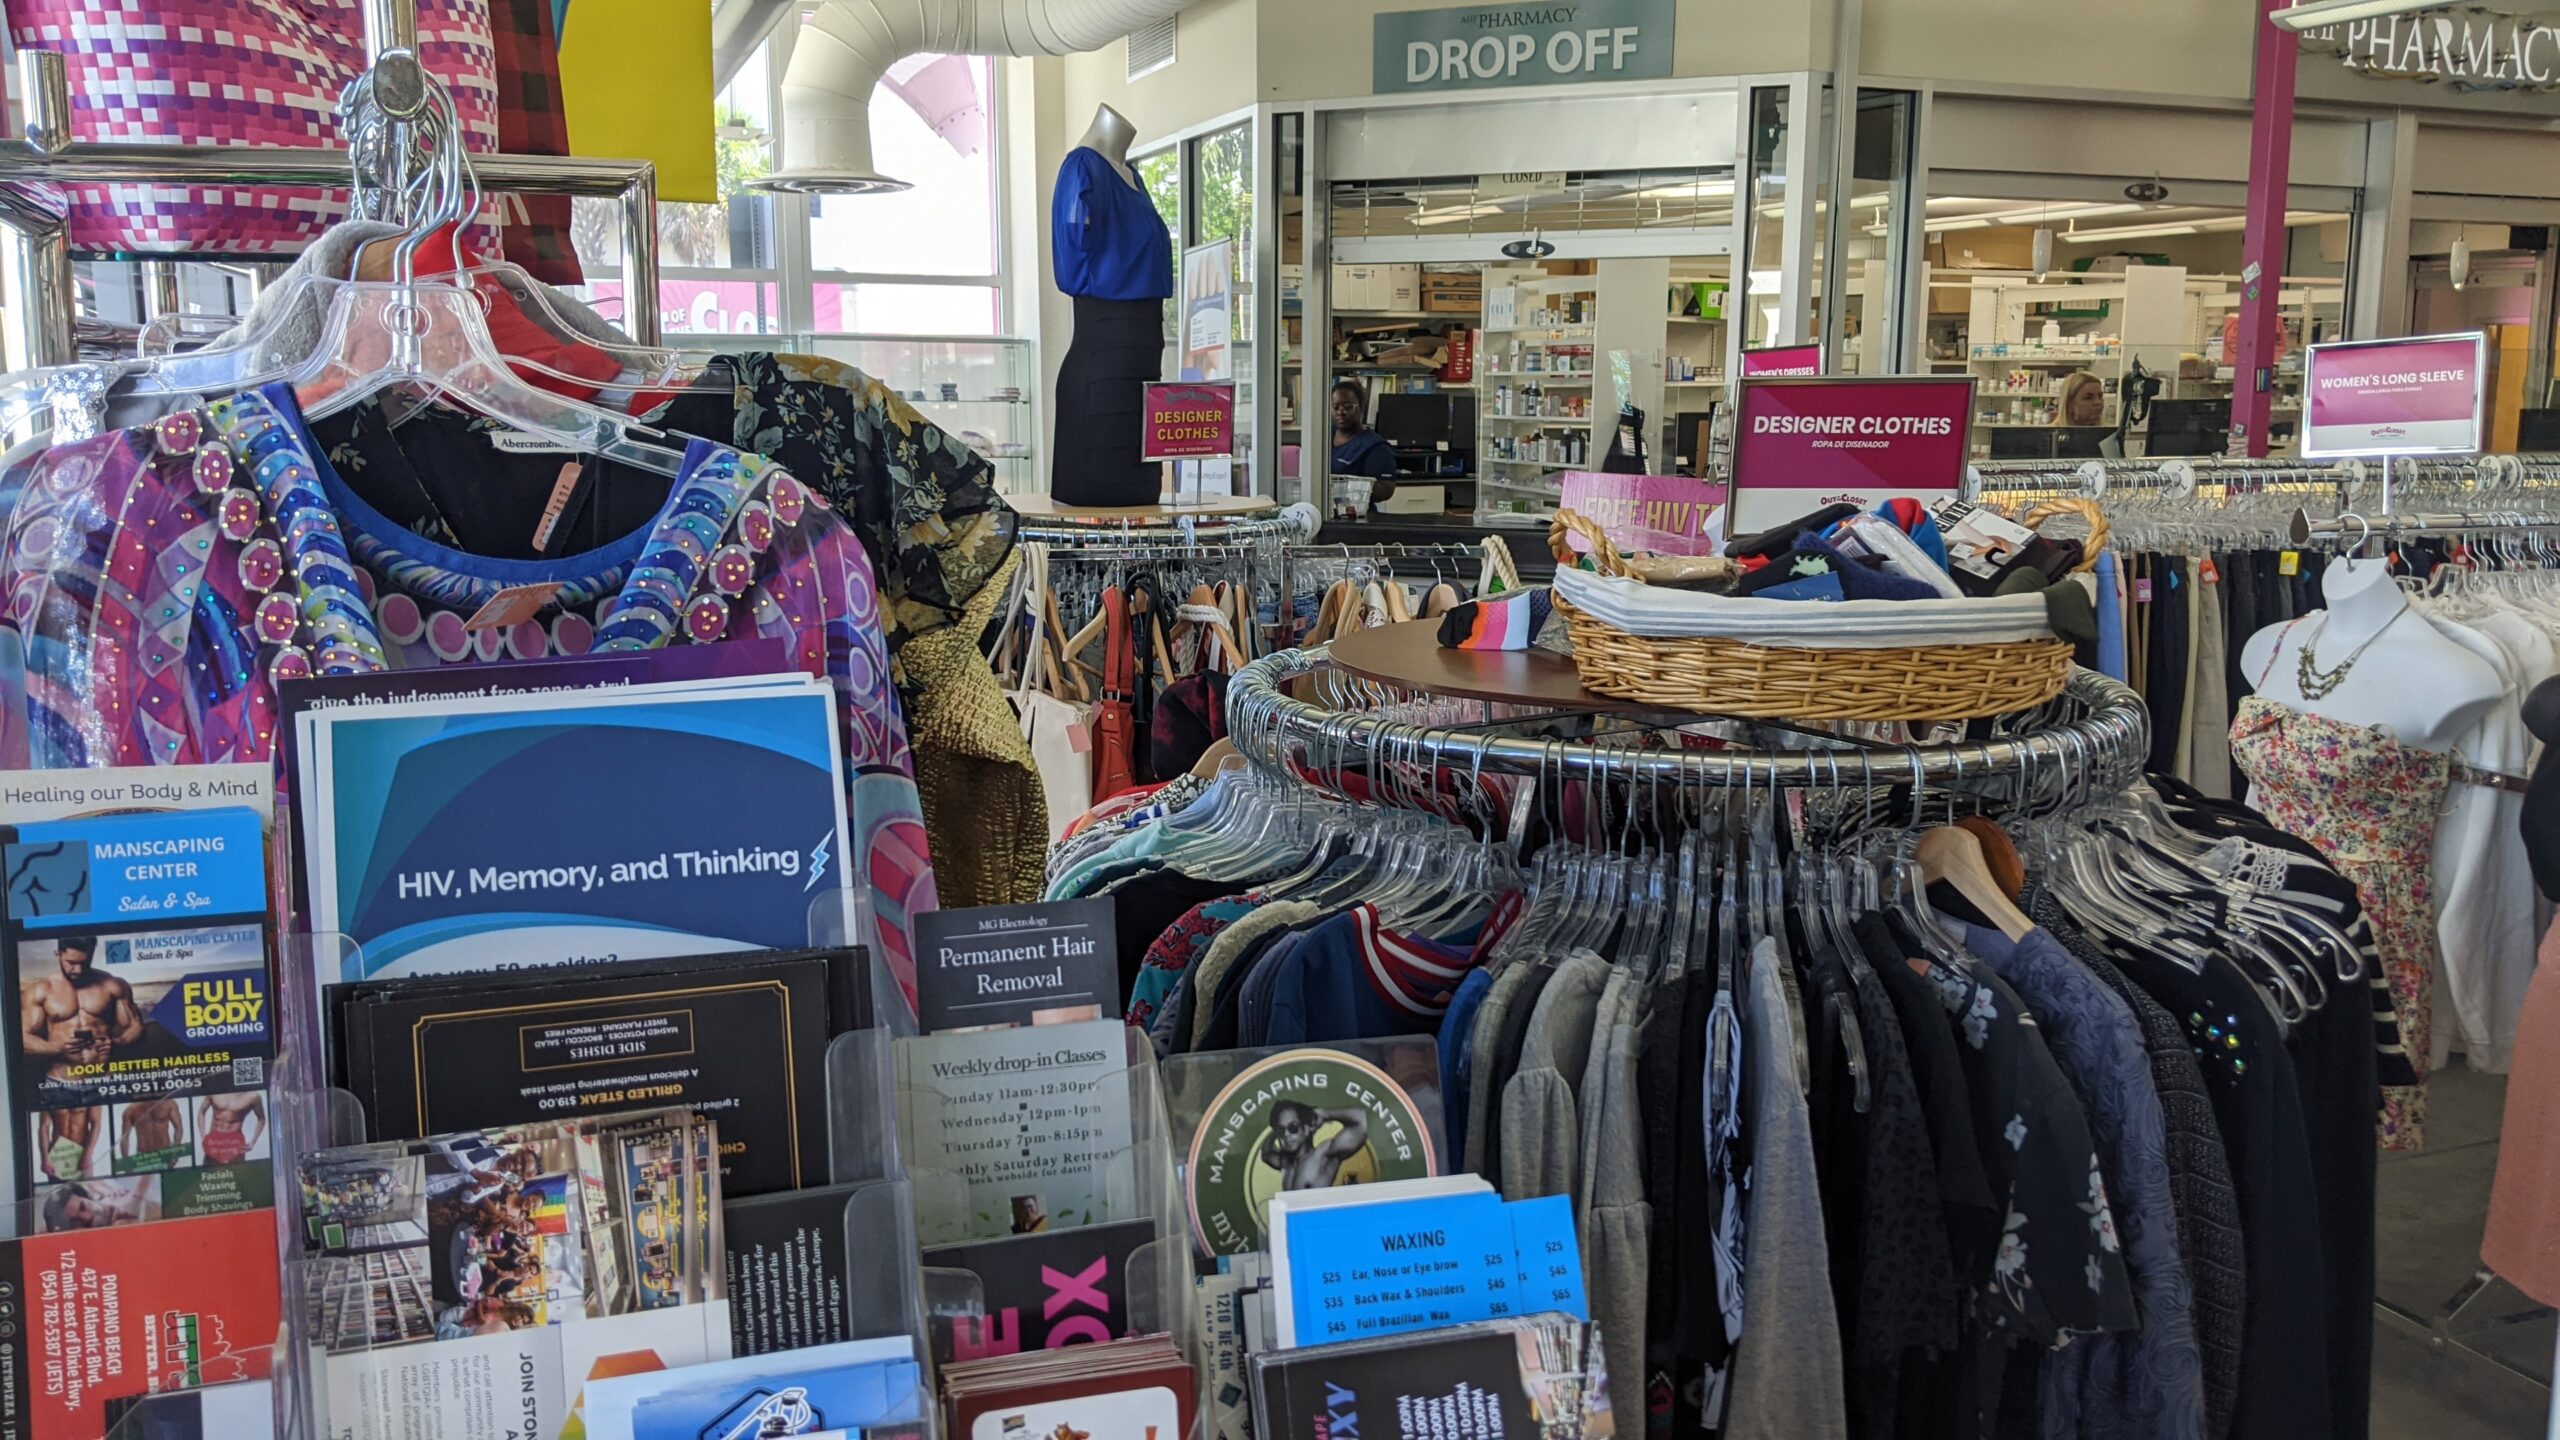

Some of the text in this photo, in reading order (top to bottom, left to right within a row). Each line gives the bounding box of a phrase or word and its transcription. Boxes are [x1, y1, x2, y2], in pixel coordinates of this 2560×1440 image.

[1479, 8, 1576, 28] PHARMACY
[1407, 26, 1639, 83] DROP OFF
[2343, 15, 2560, 82] PHARMAC
[671, 308, 686, 323] OF
[1784, 367, 1815, 376] DRESSES
[2321, 370, 2464, 389] WOMEN'S LONG SLEEVE
[1155, 411, 1222, 424] DESIGNER
[1753, 416, 1952, 435] DESIGNER CLOTHES
[1157, 427, 1219, 440] CLOTHES
[1812, 440, 1833, 448] ROPA
[1820, 493, 1868, 507] OUT CLOSET
[1584, 496, 1641, 528] FREE
[1645, 501, 1691, 535] HIV
[5, 780, 258, 804] Healing our Body & Mind
[95, 836, 225, 859] MANSCAPING
[125, 862, 198, 881] CENTER
[398, 846, 801, 899] HIV, Memory, and Thinking
[118, 891, 211, 912] Salon & Spa
[978, 915, 1048, 931] MG Electrology
[134, 930, 257, 950] MANSCAPING CENTER
[137, 949, 193, 961] Salon & Spa
[939, 936, 1095, 968] Permanent Hair
[183, 978, 263, 1005] FULL
[976, 966, 1063, 995] Removal
[185, 999, 264, 1027] BODY
[186, 1022, 264, 1038] GROOMING
[534, 1026, 679, 1048] MASHED POTATOES BROCCOLI SALAD
[544, 1018, 668, 1038] SWEET PLANTAINS FRENCH FRIES
[570, 1040, 647, 1059] SIDE DISHES
[66, 1052, 230, 1076] LOOK BETTER HAIRLESS
[84, 1064, 231, 1085] www.ManscapingCenter.com
[933, 1050, 1106, 1078] Weekly drop-in Classes
[520, 1068, 699, 1097] A delicious mouthwatering sirloin steak
[539, 1083, 684, 1109] GRILLED STEAK $19.00
[703, 1099, 732, 1110] grilled
[733, 1098, 740, 1107] 2
[1210, 1073, 1411, 1183] MANSCAPING CENTER
[201, 1170, 234, 1181] Facials
[994, 1156, 1058, 1172] Saturday
[195, 1190, 241, 1203] Trimming
[199, 1181, 236, 1192] Waxing
[184, 1200, 253, 1216] Body Shavings
[1381, 1230, 1445, 1252] WAXING
[1545, 1240, 1563, 1253] $25
[742, 1254, 750, 1277] been
[785, 1241, 796, 1292] permanent
[797, 1228, 809, 1298] throughout the
[1322, 1253, 1502, 1285] $25 Ear, Nose or Eye brow $25
[1549, 1264, 1567, 1278] $45
[755, 1244, 767, 1335] work worldwide for
[1324, 1278, 1505, 1310] $35 Back Wax & Shoulders $45
[1552, 1288, 1570, 1301] $65
[102, 1274, 122, 1375] POMPANO BEACH
[745, 1297, 753, 1330] Carulla
[817, 1309, 826, 1332] Latin
[1327, 1302, 1508, 1334] $45 Full Brazilian Wax $65
[39, 1270, 64, 1395] (954) 782-5387 (JETS)
[60, 1250, 83, 1411] 1/2 mile east of Dixie Hwy.
[81, 1267, 103, 1388] 437 E. Atlantic Blvd.
[1217, 1293, 1233, 1370] 1210 NE 4th
[144, 1315, 158, 1375] BETTER.
[1, 1343, 15, 1417] @JETSPIZZA
[519, 1352, 534, 1393] JOIN
[1454, 1381, 1473, 1435] 10:00PM
